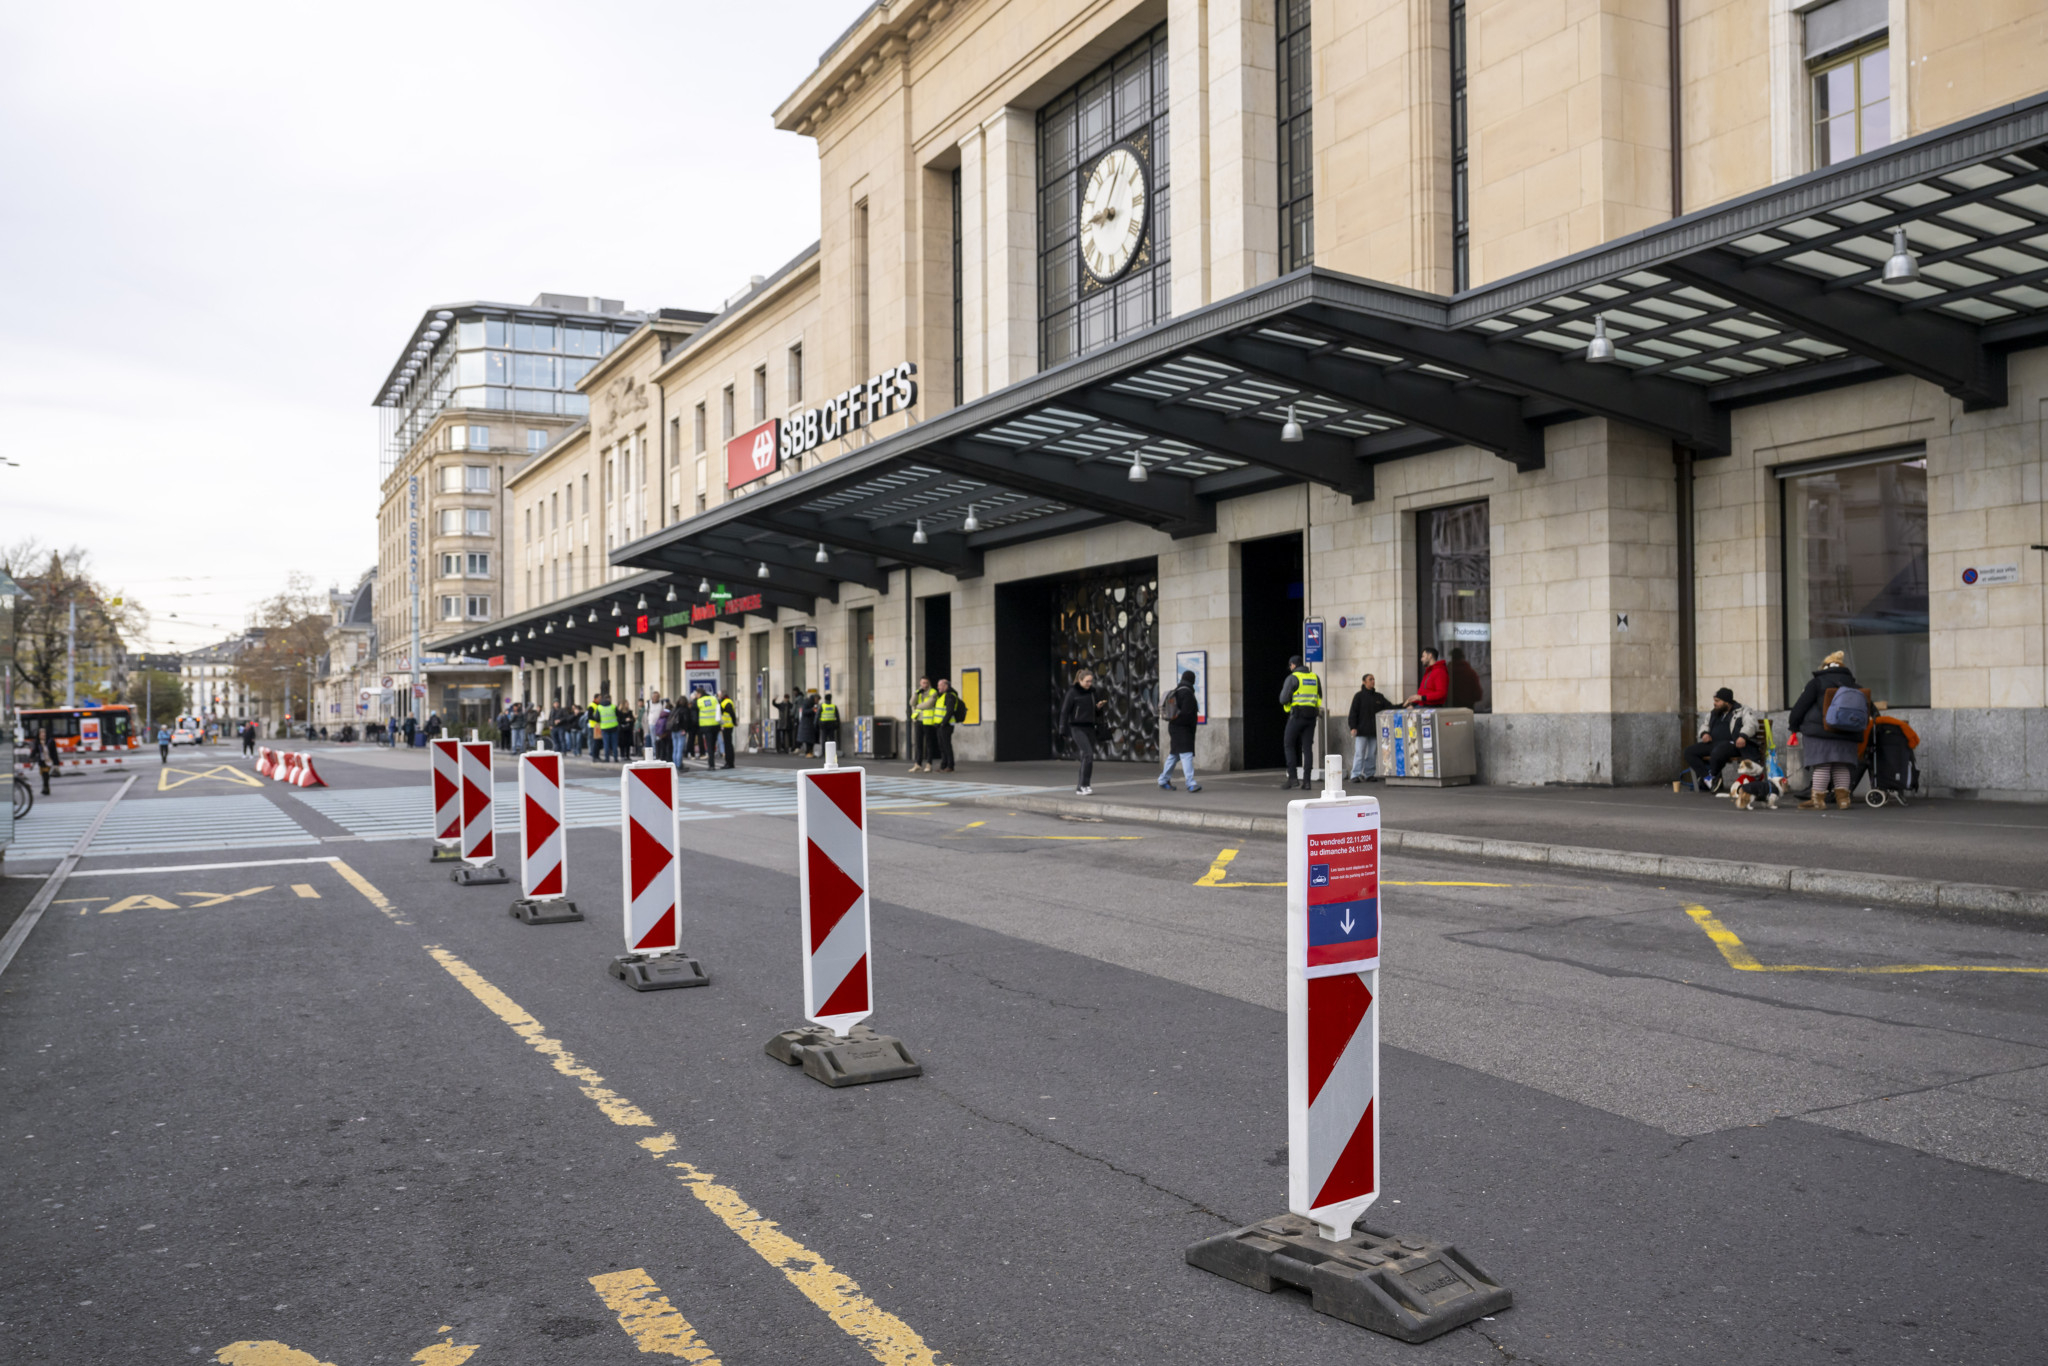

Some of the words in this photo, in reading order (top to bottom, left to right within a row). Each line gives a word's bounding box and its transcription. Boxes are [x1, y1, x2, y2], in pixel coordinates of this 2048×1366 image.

[780, 409, 821, 460] SBB
[822, 384, 866, 441] CFF
[867, 361, 917, 424] FFS
[409, 522, 418, 590] CORNAVI
[1319, 847, 1348, 856] dimanche
[1348, 844, 1373, 853] 24.11.2024
[1320, 837, 1346, 846] vendredi
[1346, 834, 1371, 844] 22.11.2024
